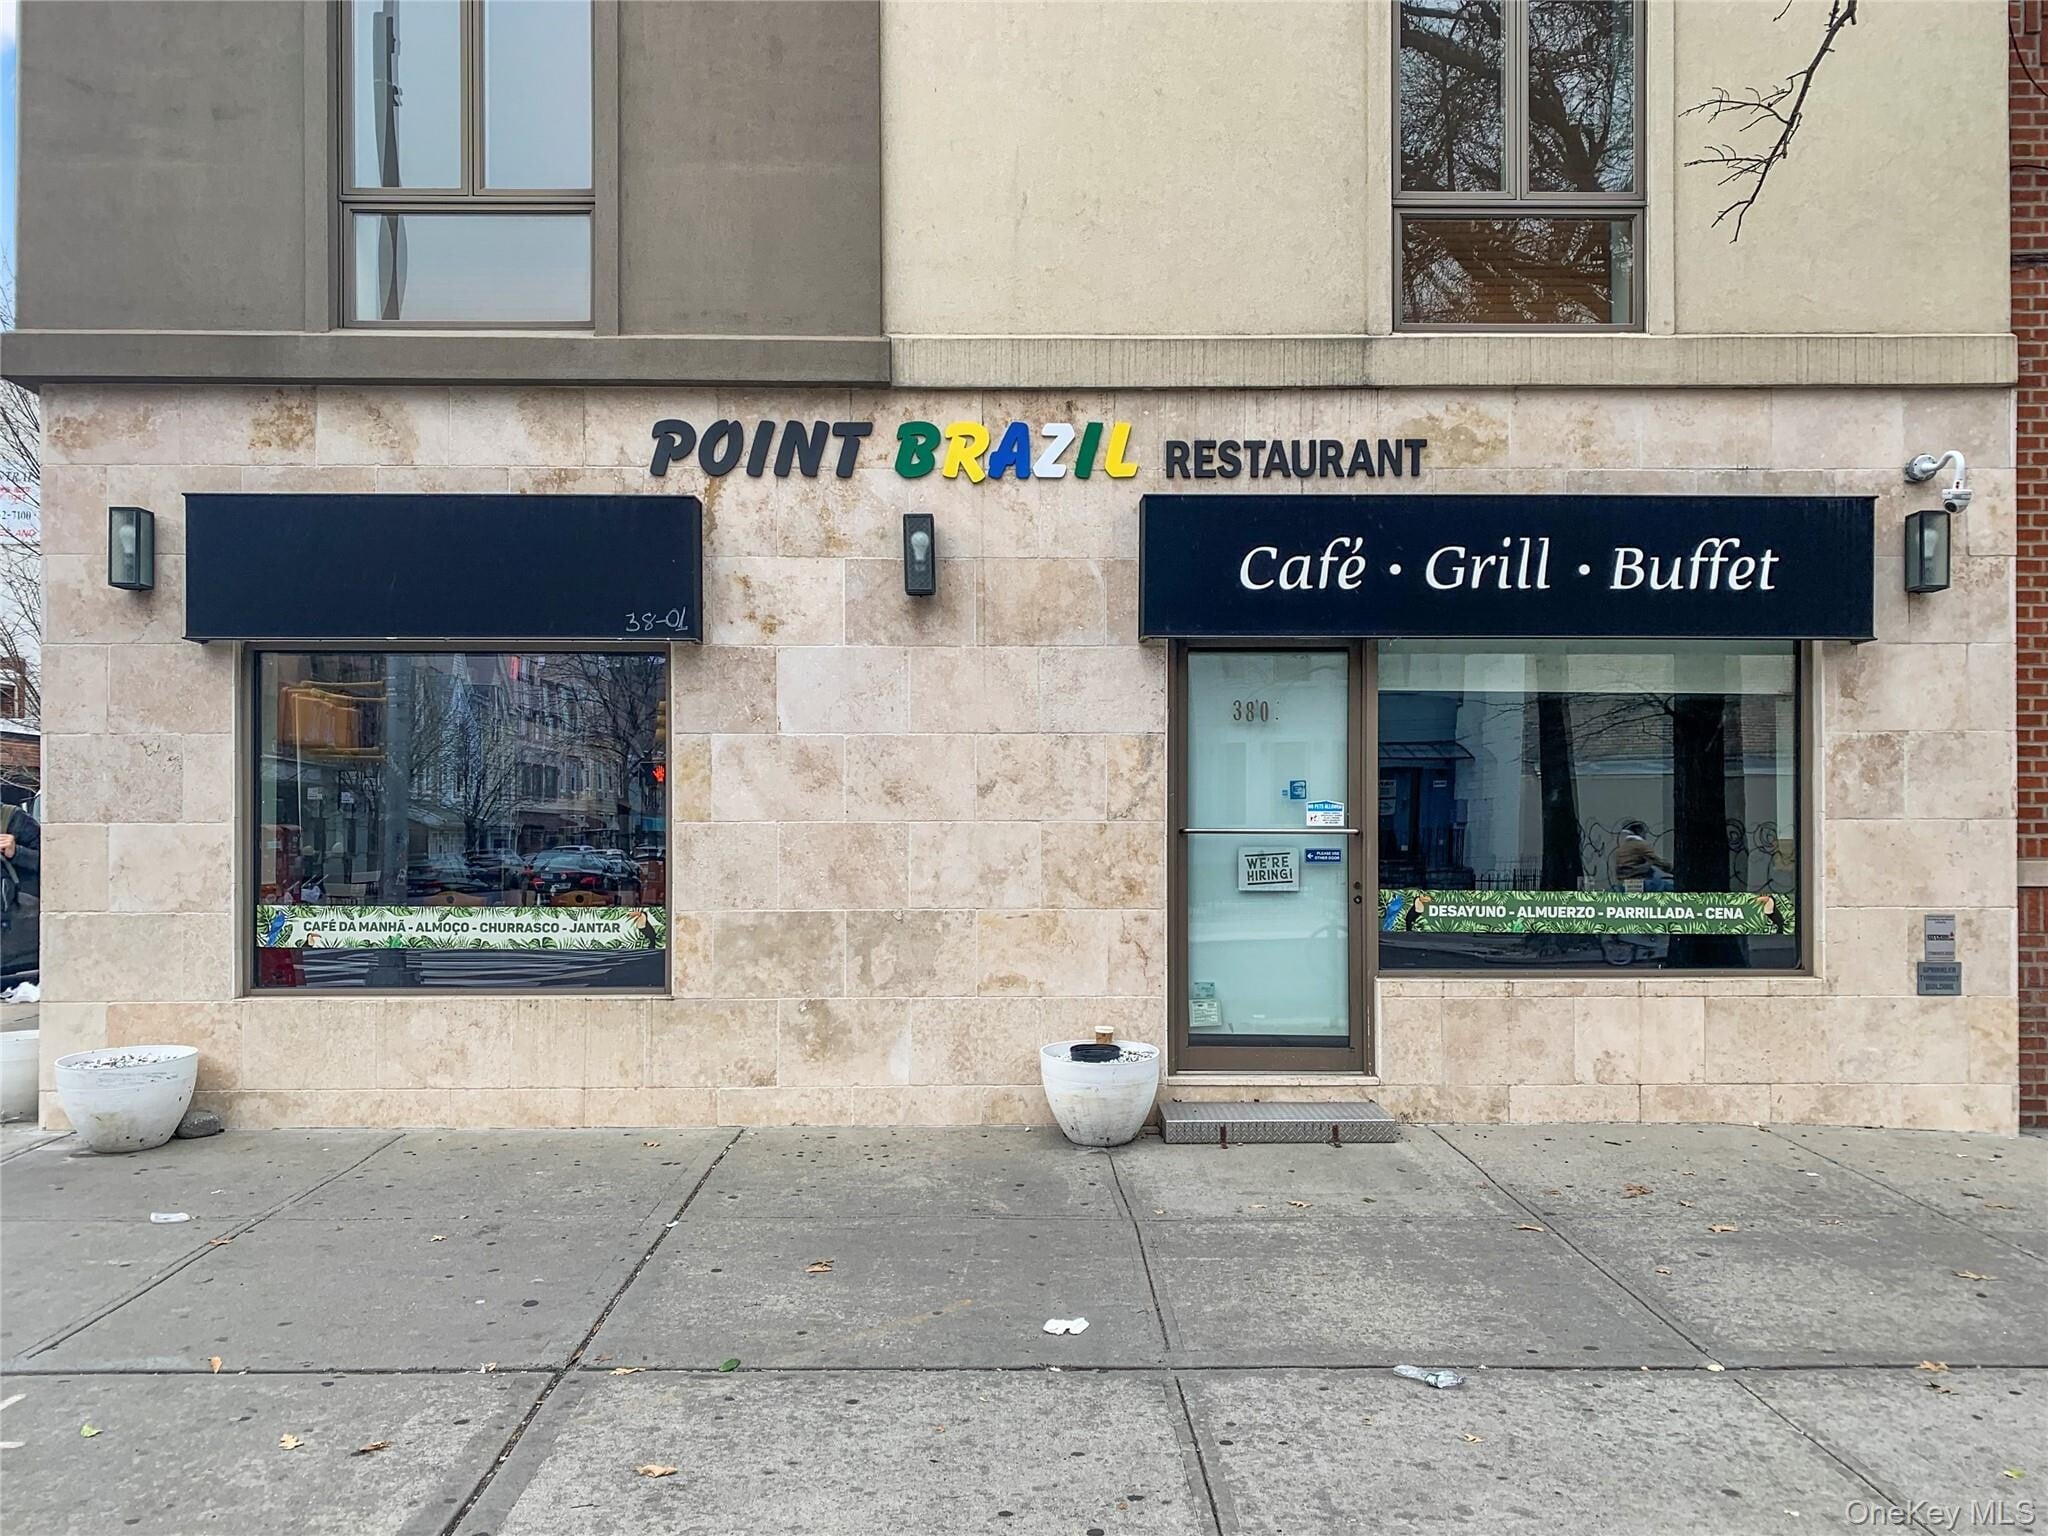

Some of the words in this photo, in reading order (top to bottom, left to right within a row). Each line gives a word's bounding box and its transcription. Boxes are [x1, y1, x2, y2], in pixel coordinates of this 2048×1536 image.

[649, 418, 874, 478] POINT
[894, 420, 1139, 484] BRAZIL
[1165, 439, 1428, 479] RESTAURANT
[1239, 536, 1367, 590] Café
[1425, 536, 1551, 590] Grill
[1609, 537, 1780, 591] Buffet
[625, 606, 689, 632] 38-01
[1246, 856, 1290, 870] WE'RE
[1428, 905, 1507, 918] DESAYUNO
[1516, 906, 1596, 919] ALMUERZO
[1606, 906, 1695, 919] PARRILLADA
[1705, 907, 1745, 920] CENA
[303, 919, 337, 932] CAFÉ
[339, 921, 357, 932] DA
[358, 919, 407, 932] MANHÃ
[415, 921, 470, 935] ALMOÇO
[479, 922, 560, 933] CHURRASCO
[569, 922, 621, 933] JANTAR
